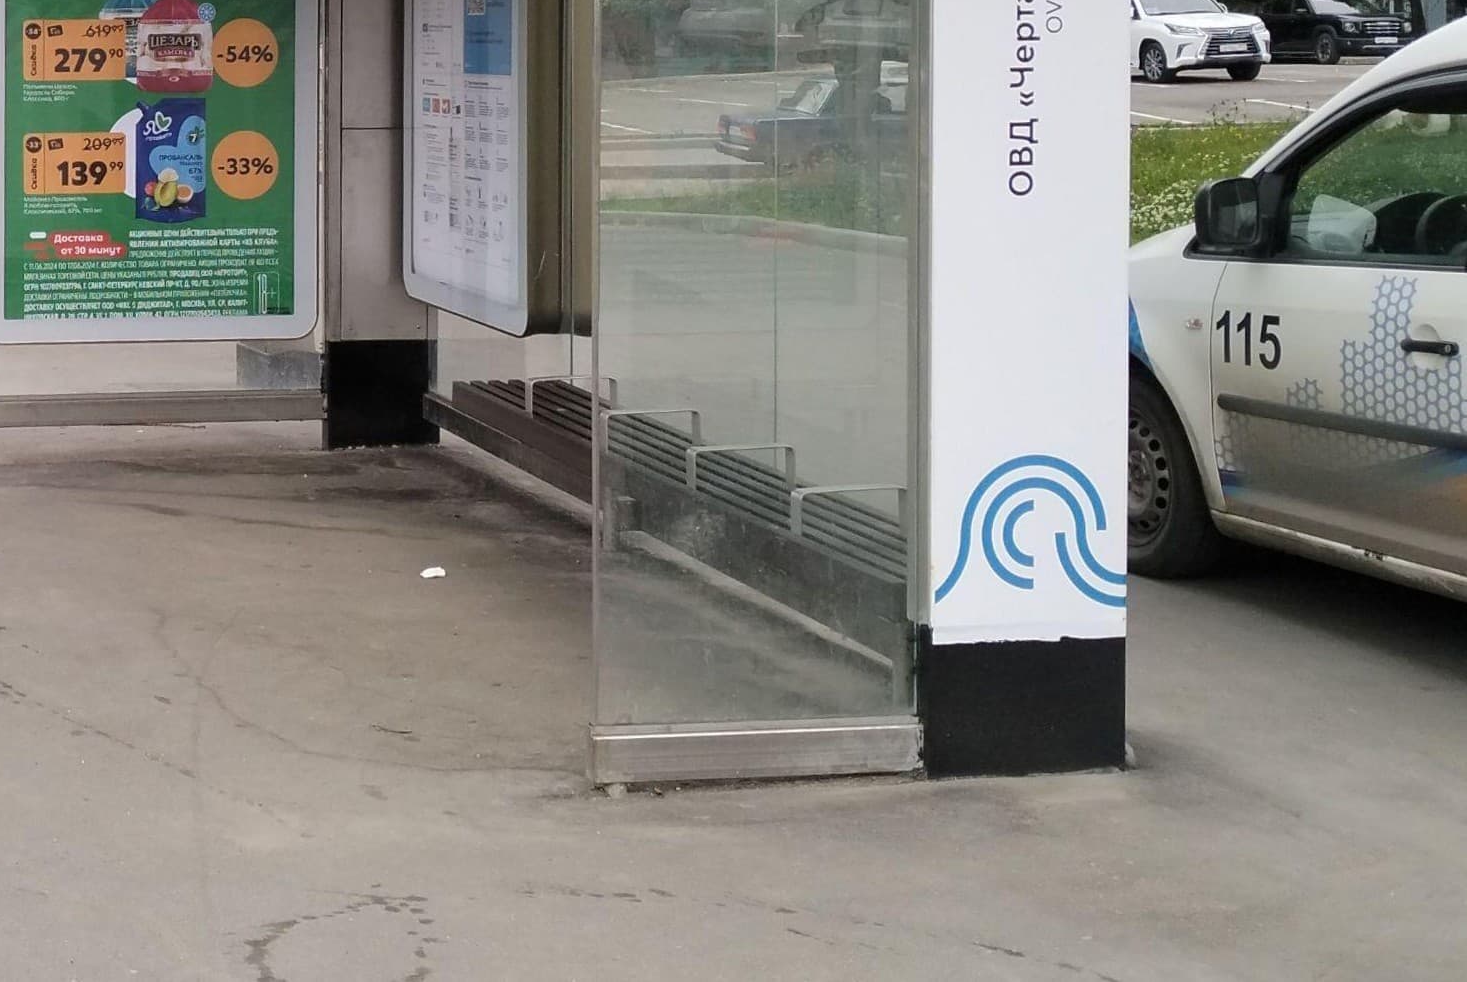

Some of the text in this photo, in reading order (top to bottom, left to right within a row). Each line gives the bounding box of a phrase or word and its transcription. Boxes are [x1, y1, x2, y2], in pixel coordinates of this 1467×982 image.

[150, 35, 199, 47] ЦЕЗАРЬ
[54, 48, 124, 72] 279 90
[217, 45, 274, 63] -54%
[218, 157, 274, 175] -33%
[1009, 118, 1038, 196] ОВД
[56, 161, 124, 186] 139 99
[53, 234, 104, 244] Доставка
[74, 246, 86, 255] 30
[88, 246, 122, 256] минут
[257, 273, 277, 315] 18+
[1216, 309, 1282, 370] 115
